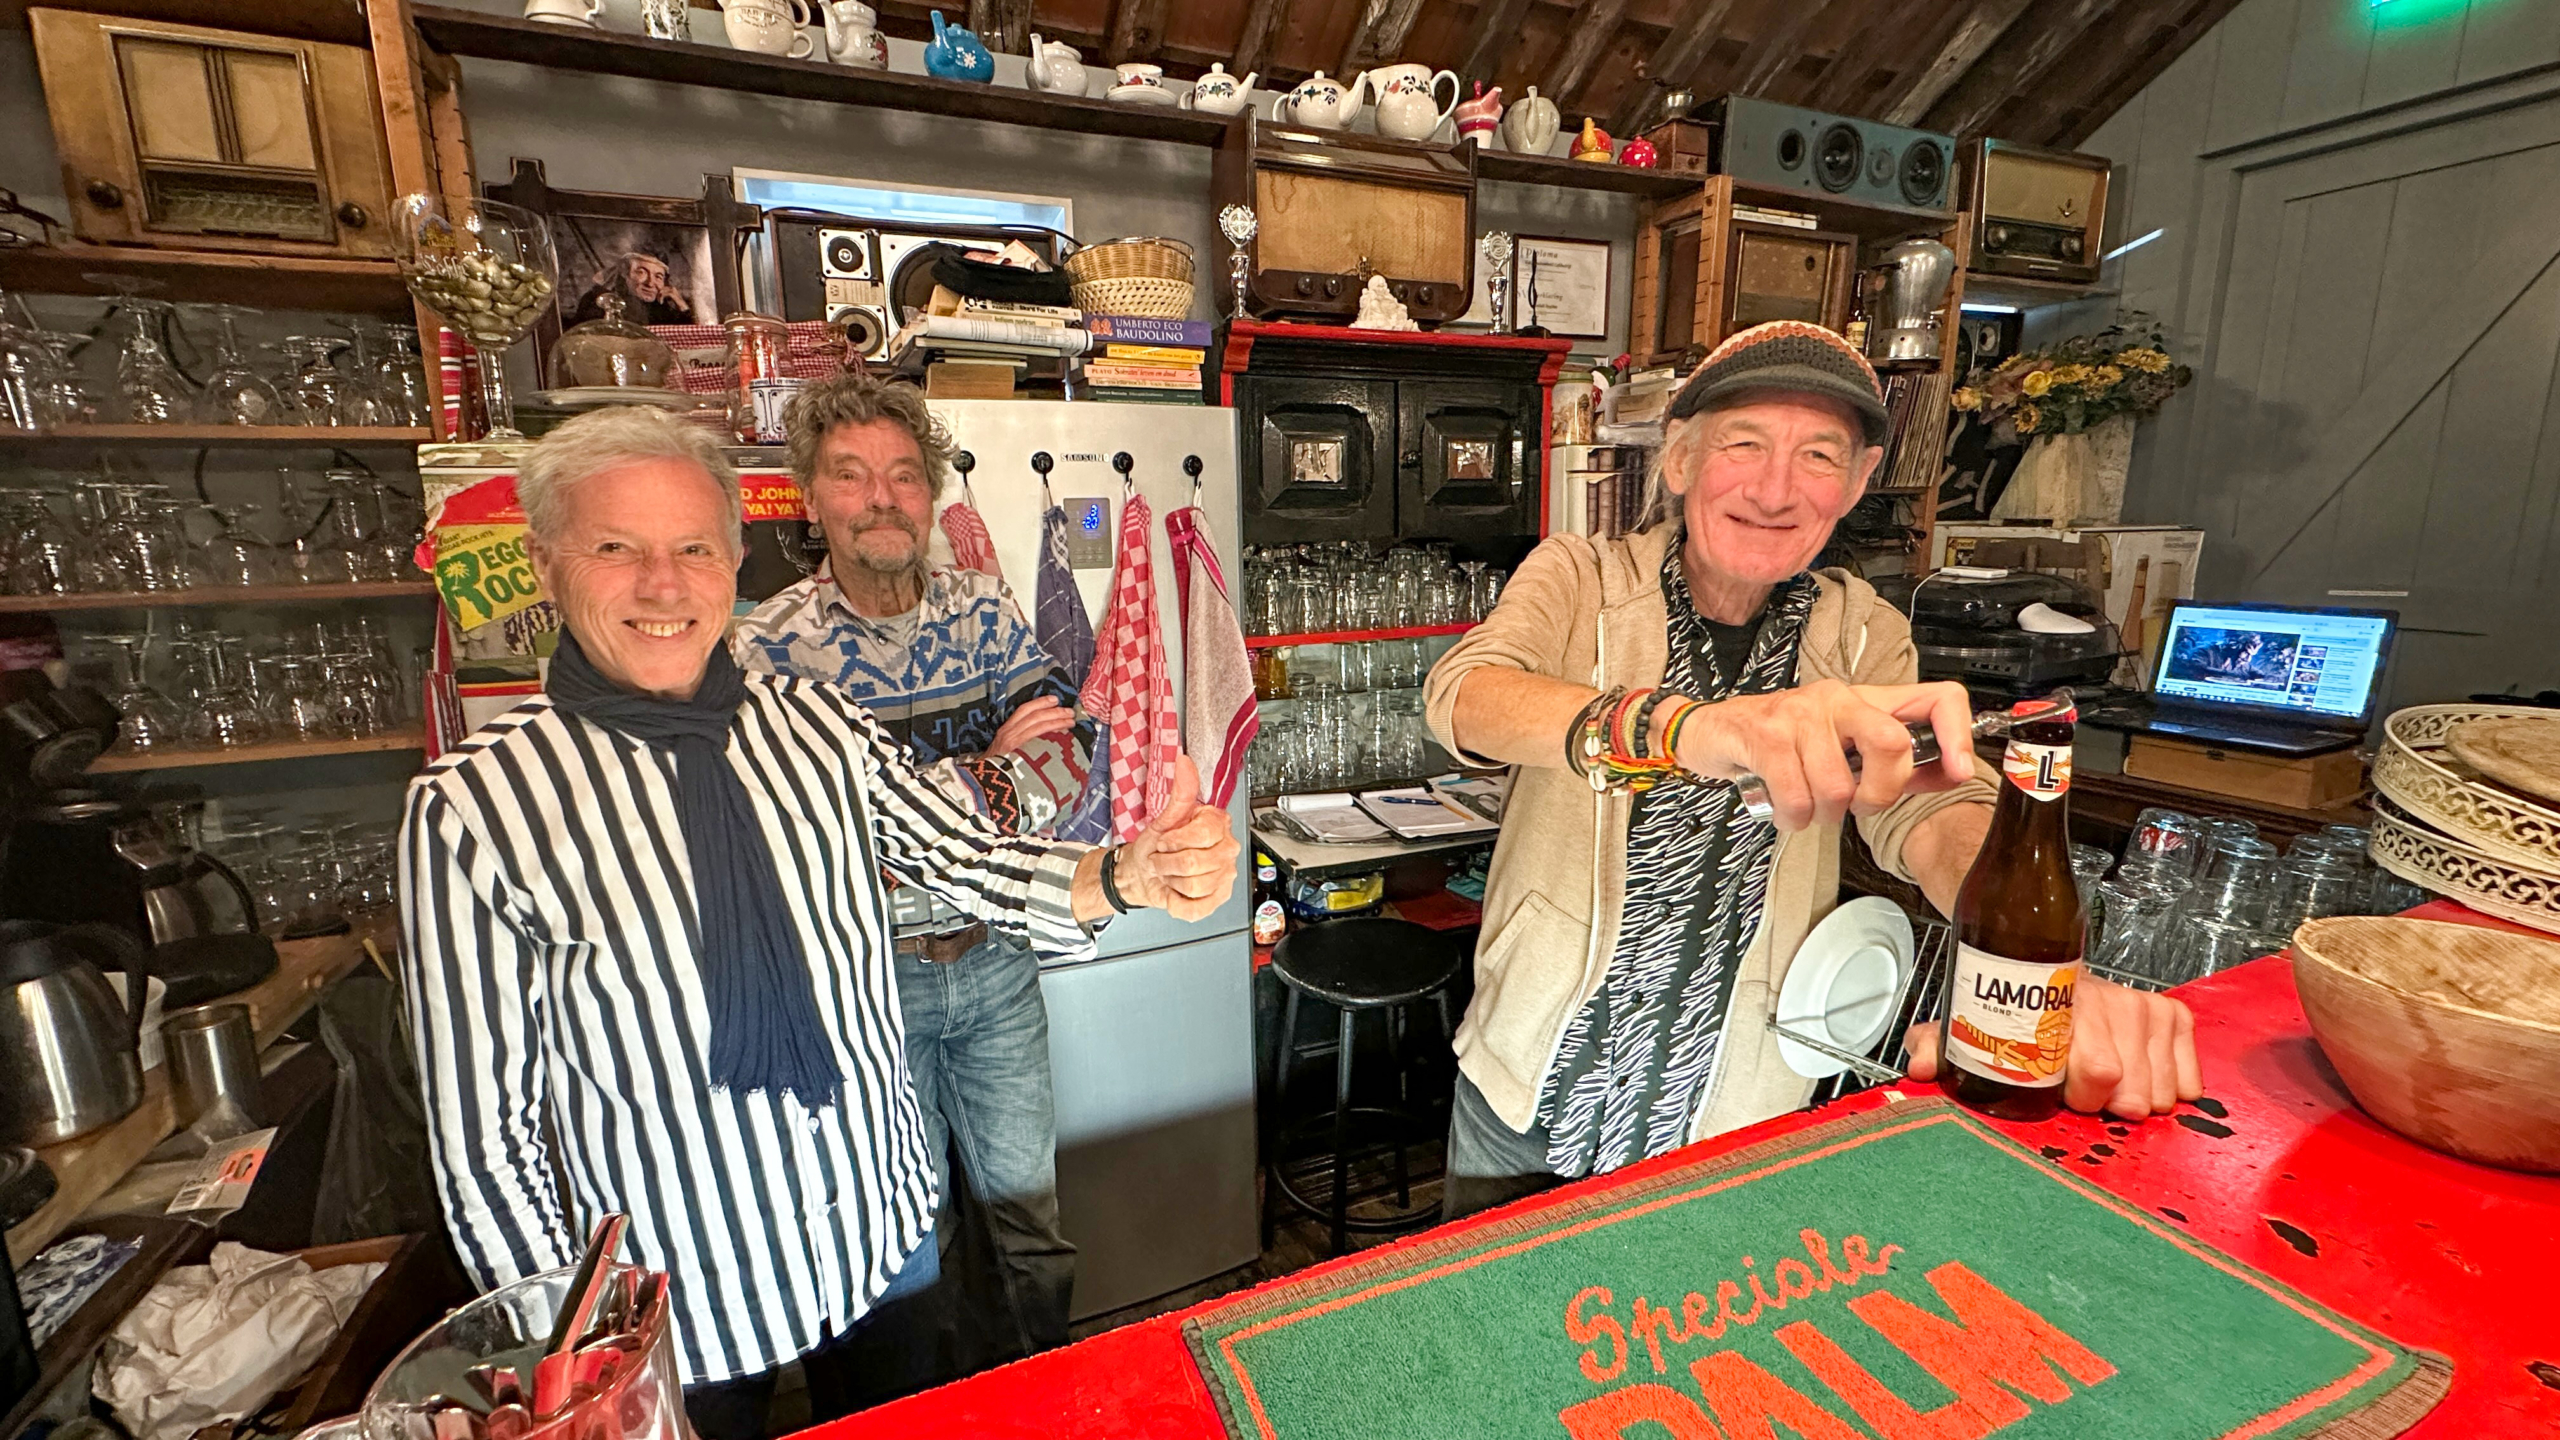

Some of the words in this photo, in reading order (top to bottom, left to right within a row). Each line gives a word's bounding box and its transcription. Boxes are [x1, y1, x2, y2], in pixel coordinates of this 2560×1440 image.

[1116, 318, 1161, 329] UMBERTO
[1164, 321, 1183, 331] ECO
[1116, 329, 1184, 342] BAUDOLINO
[1060, 453, 1110, 463] SAMSUNG
[1091, 504, 1098, 517] 3
[1982, 1002, 2012, 1017] BLOND
[1564, 1228, 1905, 1383] Speciale
